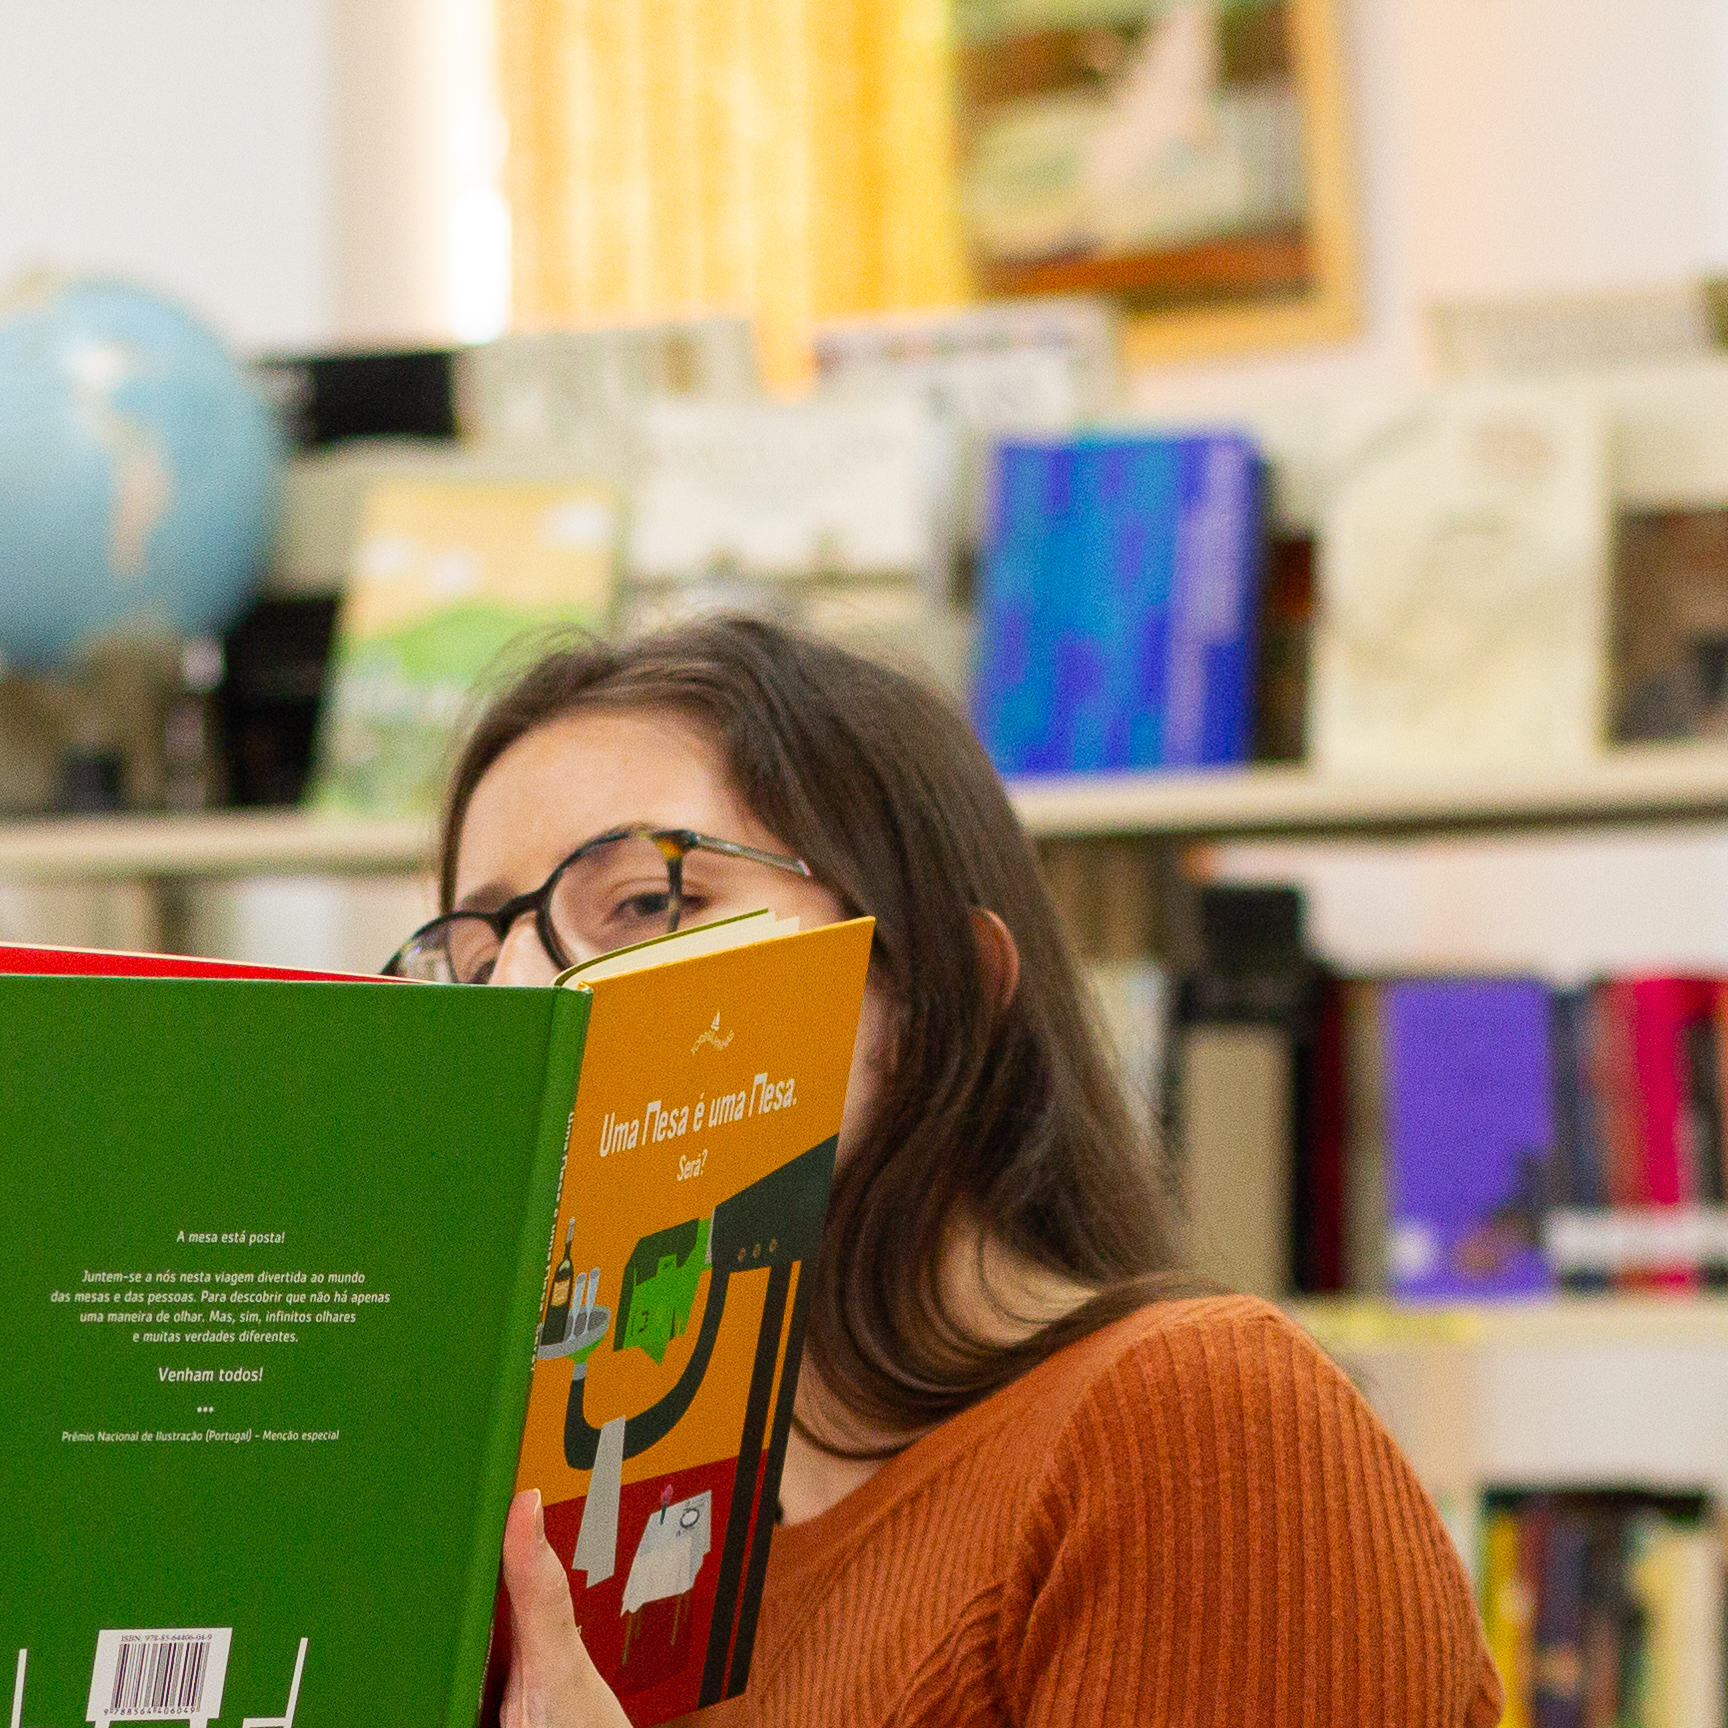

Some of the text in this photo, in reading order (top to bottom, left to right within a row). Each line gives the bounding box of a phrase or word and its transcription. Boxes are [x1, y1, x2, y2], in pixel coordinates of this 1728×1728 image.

[600, 1112, 639, 1157] Uma
[693, 1093, 705, 1131] é
[708, 1091, 747, 1128] uma
[677, 1149, 708, 1181] Será?
[176, 1229, 286, 1247] A mesa está posta!
[81, 1269, 365, 1286] Juntem-se a nós nesta viagem divertida ao mundo
[50, 1289, 391, 1305] das mesas e das pessoas. Para descobrir que não há apenas
[80, 1310, 357, 1324] uma maneira de olhar. Mas, sim, infinitos olhares
[133, 1330, 299, 1343] e muitas verdades diferentes.
[158, 1366, 264, 1382] Venham todos!
[61, 1430, 95, 1442] Prémio
[97, 1430, 139, 1442] Nacional
[141, 1430, 153, 1441] de
[155, 1429, 203, 1442] Ilustração
[205, 1428, 252, 1443] (Portugal)
[262, 1429, 299, 1442] Menção
[301, 1429, 340, 1443] especial
